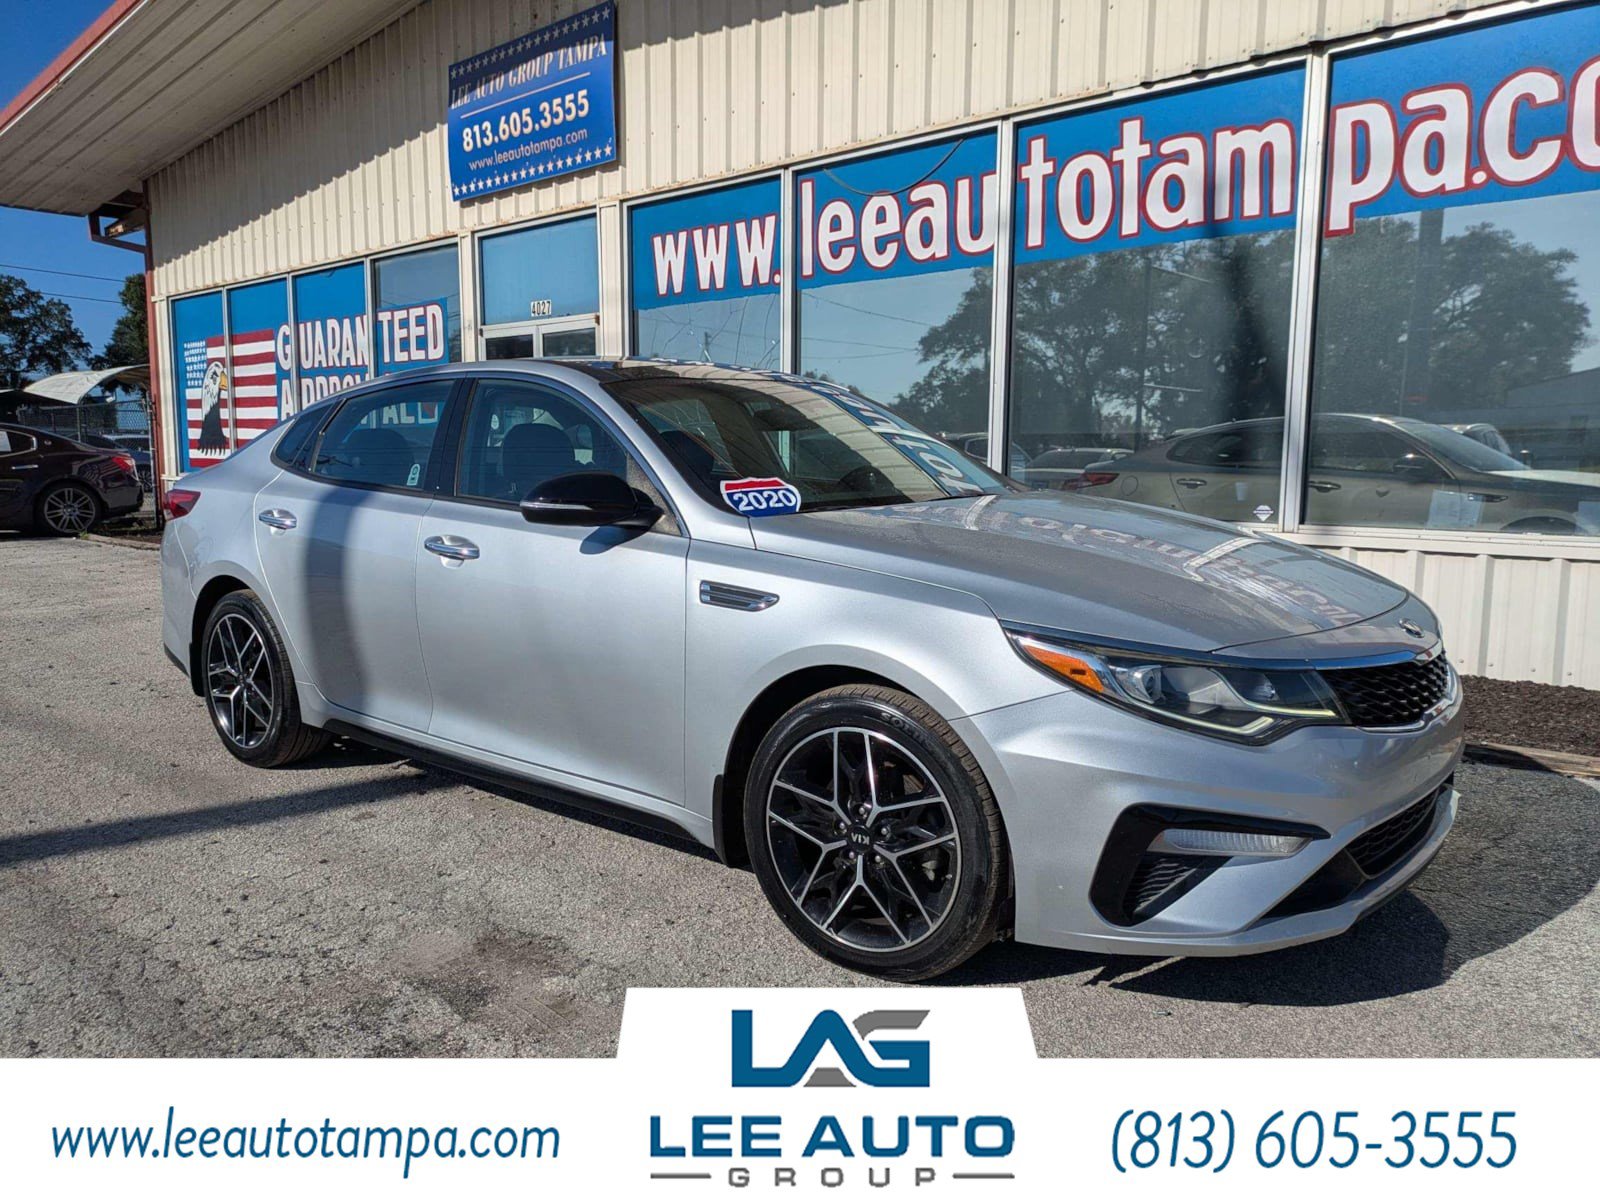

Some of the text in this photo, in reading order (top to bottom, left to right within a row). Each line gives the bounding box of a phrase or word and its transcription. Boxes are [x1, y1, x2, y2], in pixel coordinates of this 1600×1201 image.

[451, 33, 608, 109] LEE AUTO GROUP TAMPA
[462, 89, 590, 152] 813.605.3555
[469, 128, 588, 171] www.leeautotampa.com
[531, 300, 551, 315] 4027
[276, 303, 444, 371] GUARANTEED
[732, 490, 797, 511] 2020
[851, 832, 870, 846] KIA
